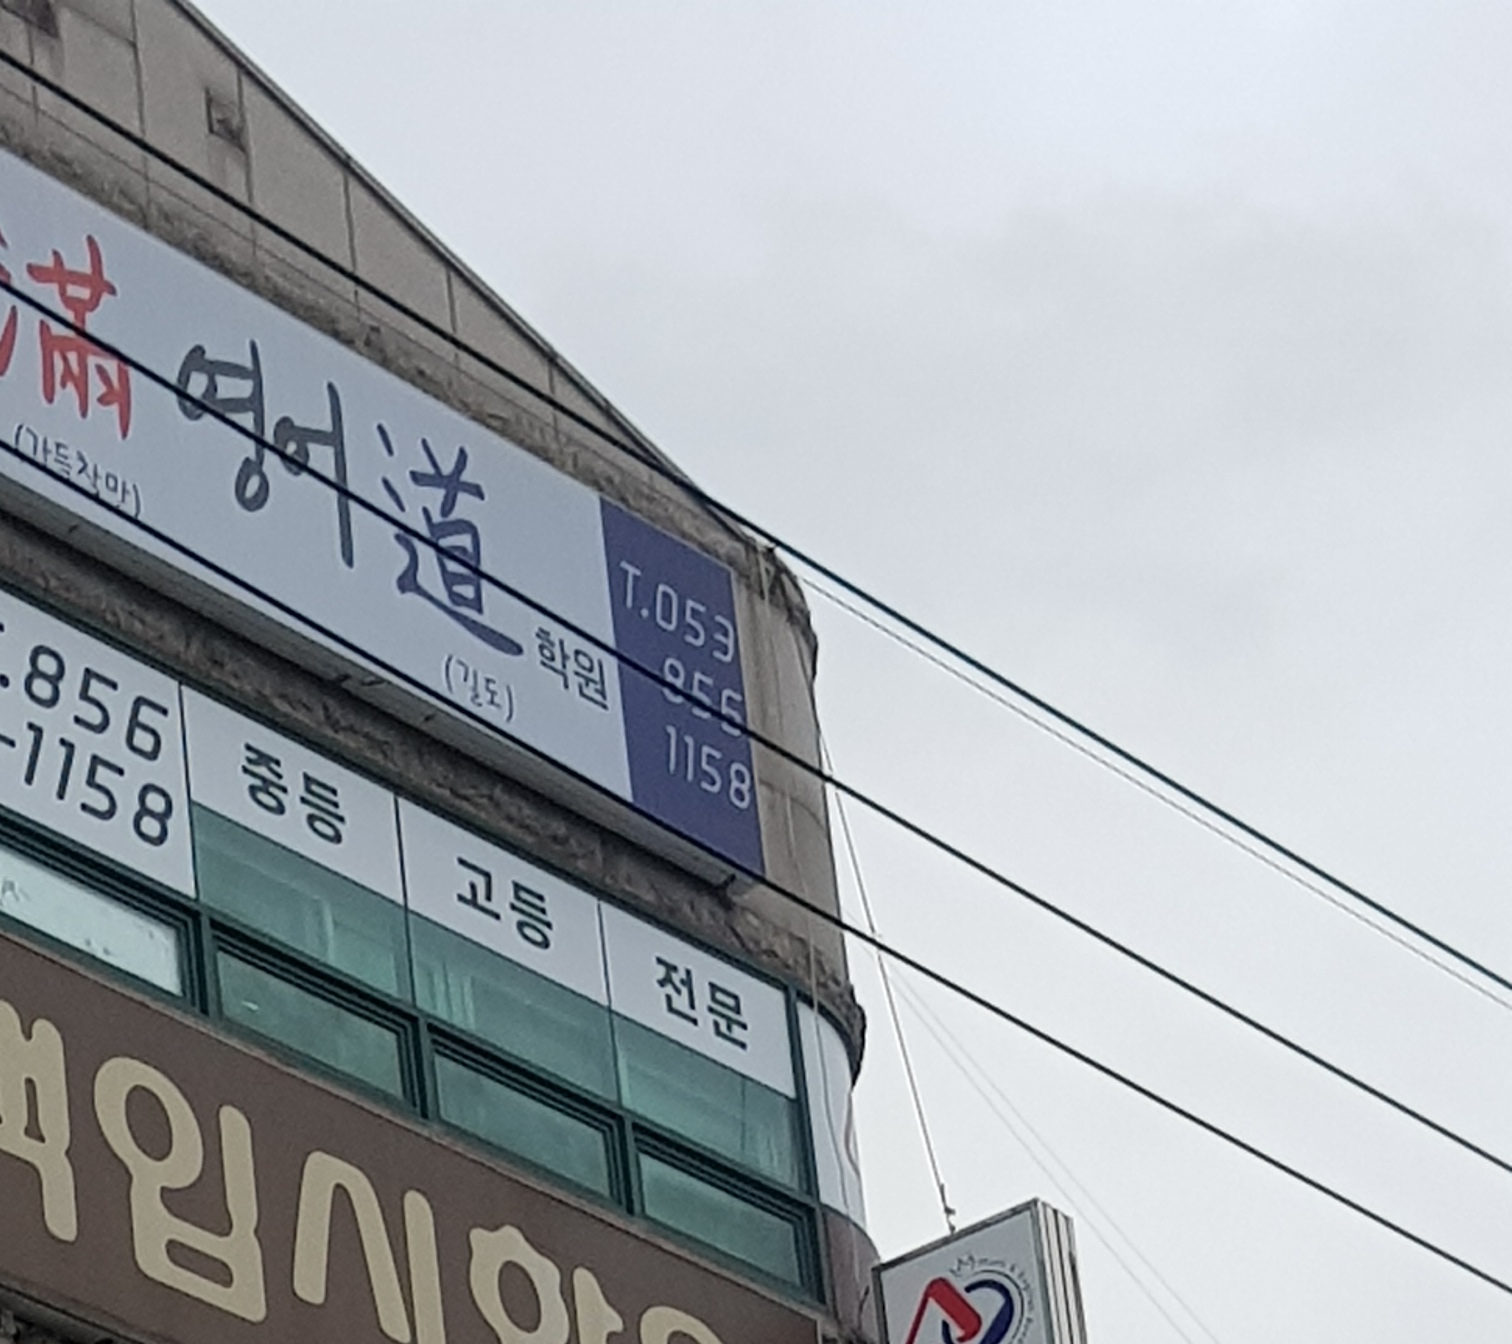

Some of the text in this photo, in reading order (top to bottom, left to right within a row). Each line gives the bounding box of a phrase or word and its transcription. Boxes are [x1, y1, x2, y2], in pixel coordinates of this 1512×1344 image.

[176, 339, 355, 570] 영어
[376, 422, 524, 657] 道
[534, 626, 610, 712] 학원
[240, 741, 749, 1050] 중등 고등 전문
[665, 724, 751, 810] 1158
